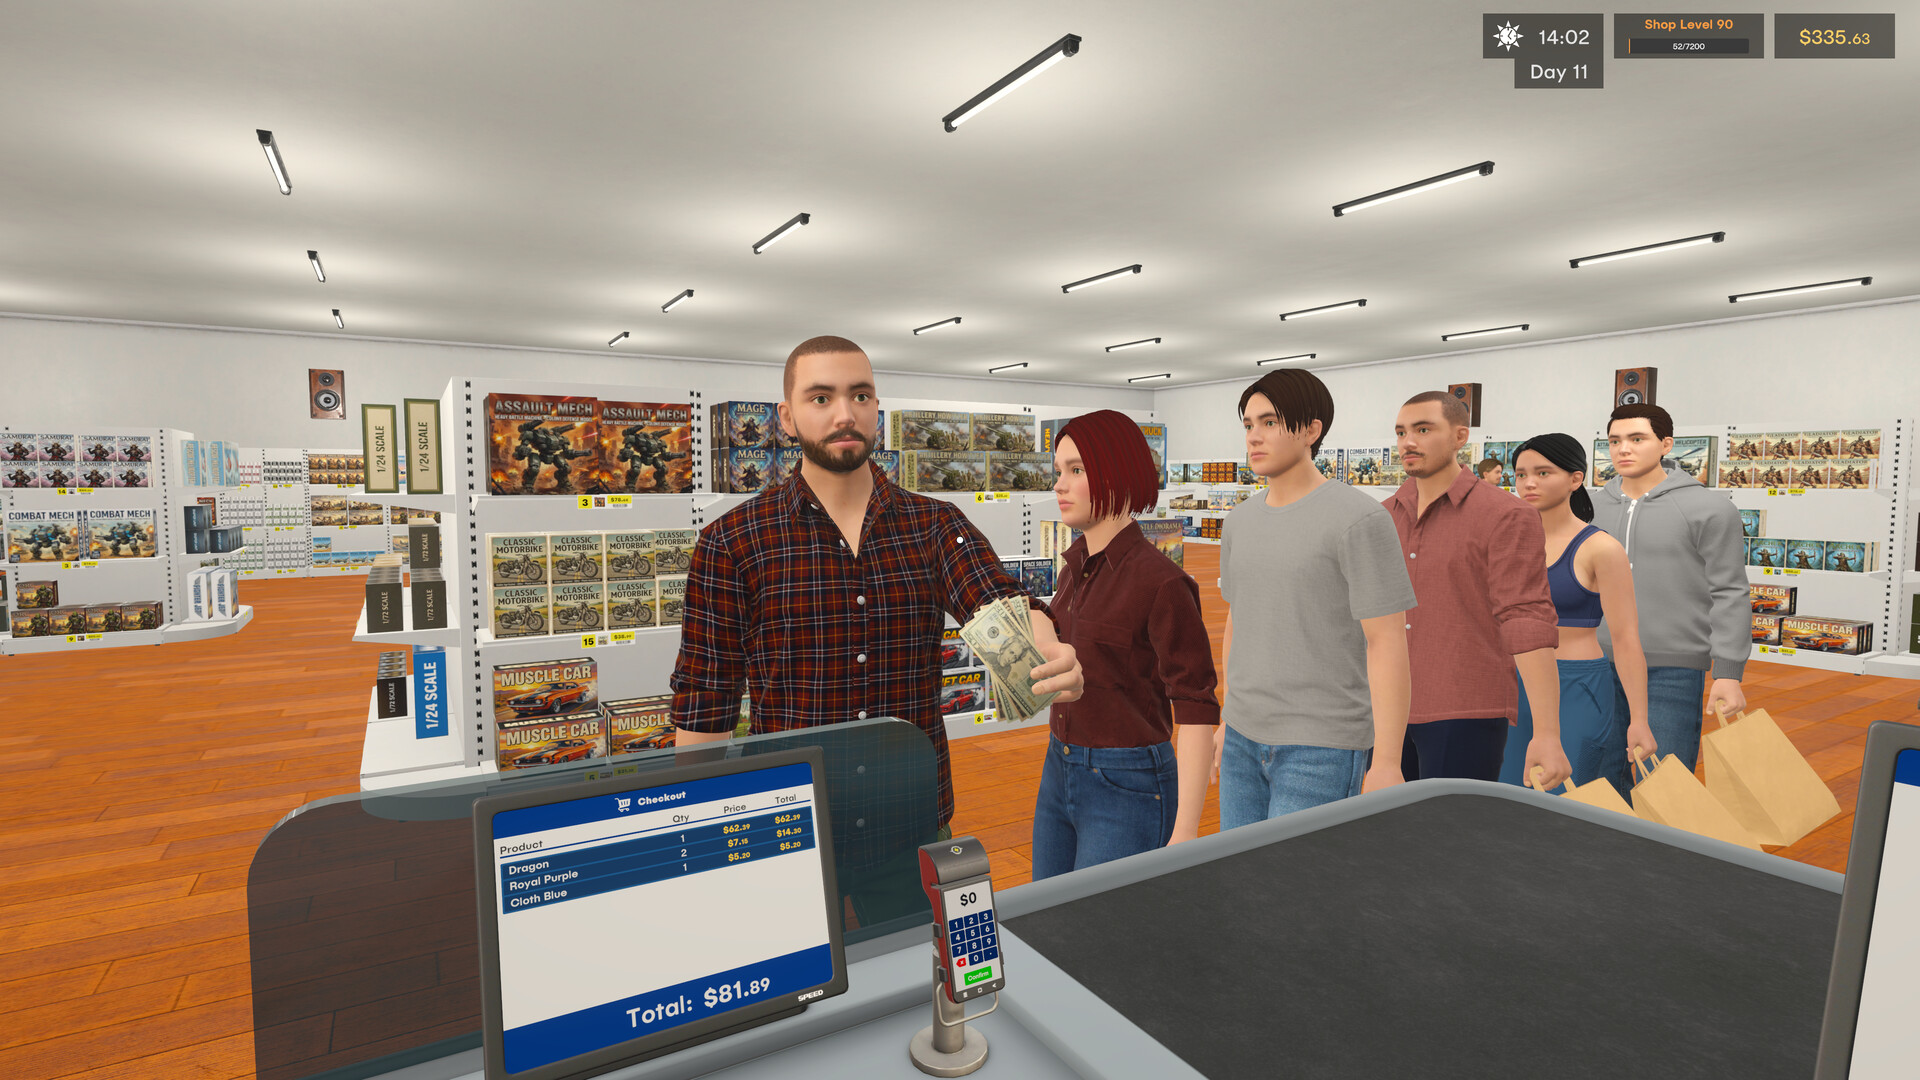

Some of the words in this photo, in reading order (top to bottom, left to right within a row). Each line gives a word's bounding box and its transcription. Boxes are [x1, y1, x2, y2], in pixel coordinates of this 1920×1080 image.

[495, 400, 554, 414] ASSAULT
[557, 402, 594, 416] MECH
[737, 404, 766, 412] MAGE
[602, 408, 653, 420] ASSAULT
[656, 410, 687, 421] MECH
[375, 426, 385, 452] SCALE
[418, 422, 428, 450] SCALE
[738, 450, 766, 458] MAGE
[784, 450, 803, 458] MAG
[376, 455, 386, 472] 1/24
[419, 452, 430, 472] 1/24
[582, 498, 588, 506] 3
[8, 512, 46, 520] COMBAT
[49, 511, 74, 520] MECH
[90, 510, 125, 518] COMBAT
[503, 538, 536, 546] CLASSIC
[561, 536, 593, 544] CLASSIC
[616, 534, 646, 542] CLASSIC
[496, 545, 543, 554] MOTORBIKE
[554, 543, 599, 552] MOTORBIKE
[609, 541, 652, 549] MOTORBIKE
[562, 586, 593, 594] CLASSIC
[617, 582, 646, 591] CLASSIC
[1766, 588, 1786, 596] CAR
[504, 589, 537, 597] CLASSIC
[556, 593, 600, 602] MOTORBIKE
[611, 590, 652, 598] MOTORBIKE
[498, 596, 544, 605] MOTORBIKE
[1756, 617, 1775, 626] CAR
[1788, 620, 1829, 632] MUSCLE
[1831, 625, 1853, 634] CAR
[584, 638, 594, 646] 15
[424, 661, 437, 701] SCALE
[501, 668, 560, 687] MUSCLE
[563, 665, 592, 680] CAR
[942, 676, 958, 686] IFT
[959, 673, 981, 684] CAR
[426, 703, 439, 730] 1/24
[617, 712, 671, 731] MUSCLE
[506, 729, 568, 746] MUSCLE
[570, 721, 599, 737] CAR
[637, 791, 687, 806] Checkout
[500, 840, 543, 855] Product
[672, 813, 690, 824] Qty
[723, 802, 747, 814] Price
[775, 793, 797, 804] Total
[508, 859, 550, 877] Dragon
[680, 834, 686, 843] 1
[723, 823, 751, 835] $62.39
[774, 813, 801, 825] $62.39
[509, 874, 541, 892] Royal
[544, 868, 579, 886] Purple
[680, 848, 687, 858] 2
[728, 837, 749, 848] $7.15
[776, 827, 802, 838] $14.30
[510, 894, 541, 908] Cloth
[544, 888, 568, 902] Blue
[682, 863, 687, 872] 1
[728, 850, 751, 862] $5.20
[779, 840, 801, 852] $5.20
[960, 892, 977, 907] $0
[968, 970, 989, 982] Confirm
[798, 989, 824, 1002] SPEED
[626, 996, 693, 1028] Total:
[704, 977, 771, 1009] $81.89
